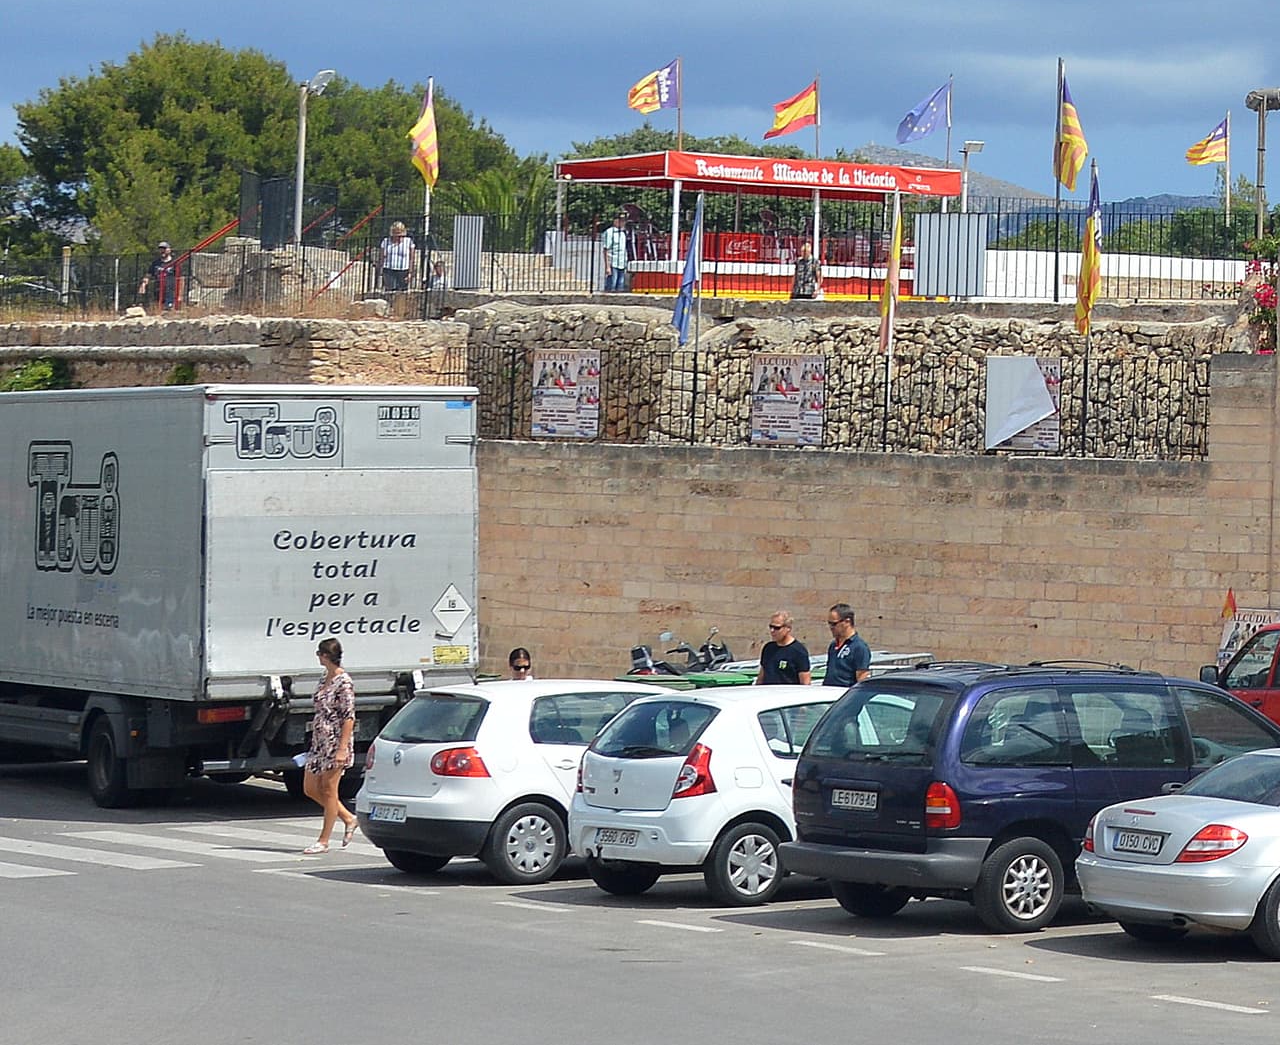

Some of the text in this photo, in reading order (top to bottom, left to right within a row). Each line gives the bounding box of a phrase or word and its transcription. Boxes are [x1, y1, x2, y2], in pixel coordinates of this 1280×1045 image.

[772, 163, 819, 183] Mirador
[821, 168, 834, 184] de
[839, 167, 850, 185] la
[853, 169, 896, 188] Victoria
[273, 530, 417, 550] Cobertura
[312, 559, 378, 579] total
[309, 592, 379, 612] per a
[27, 603, 119, 628] La mejor puesta en escena
[266, 615, 421, 641] l'espectacle
